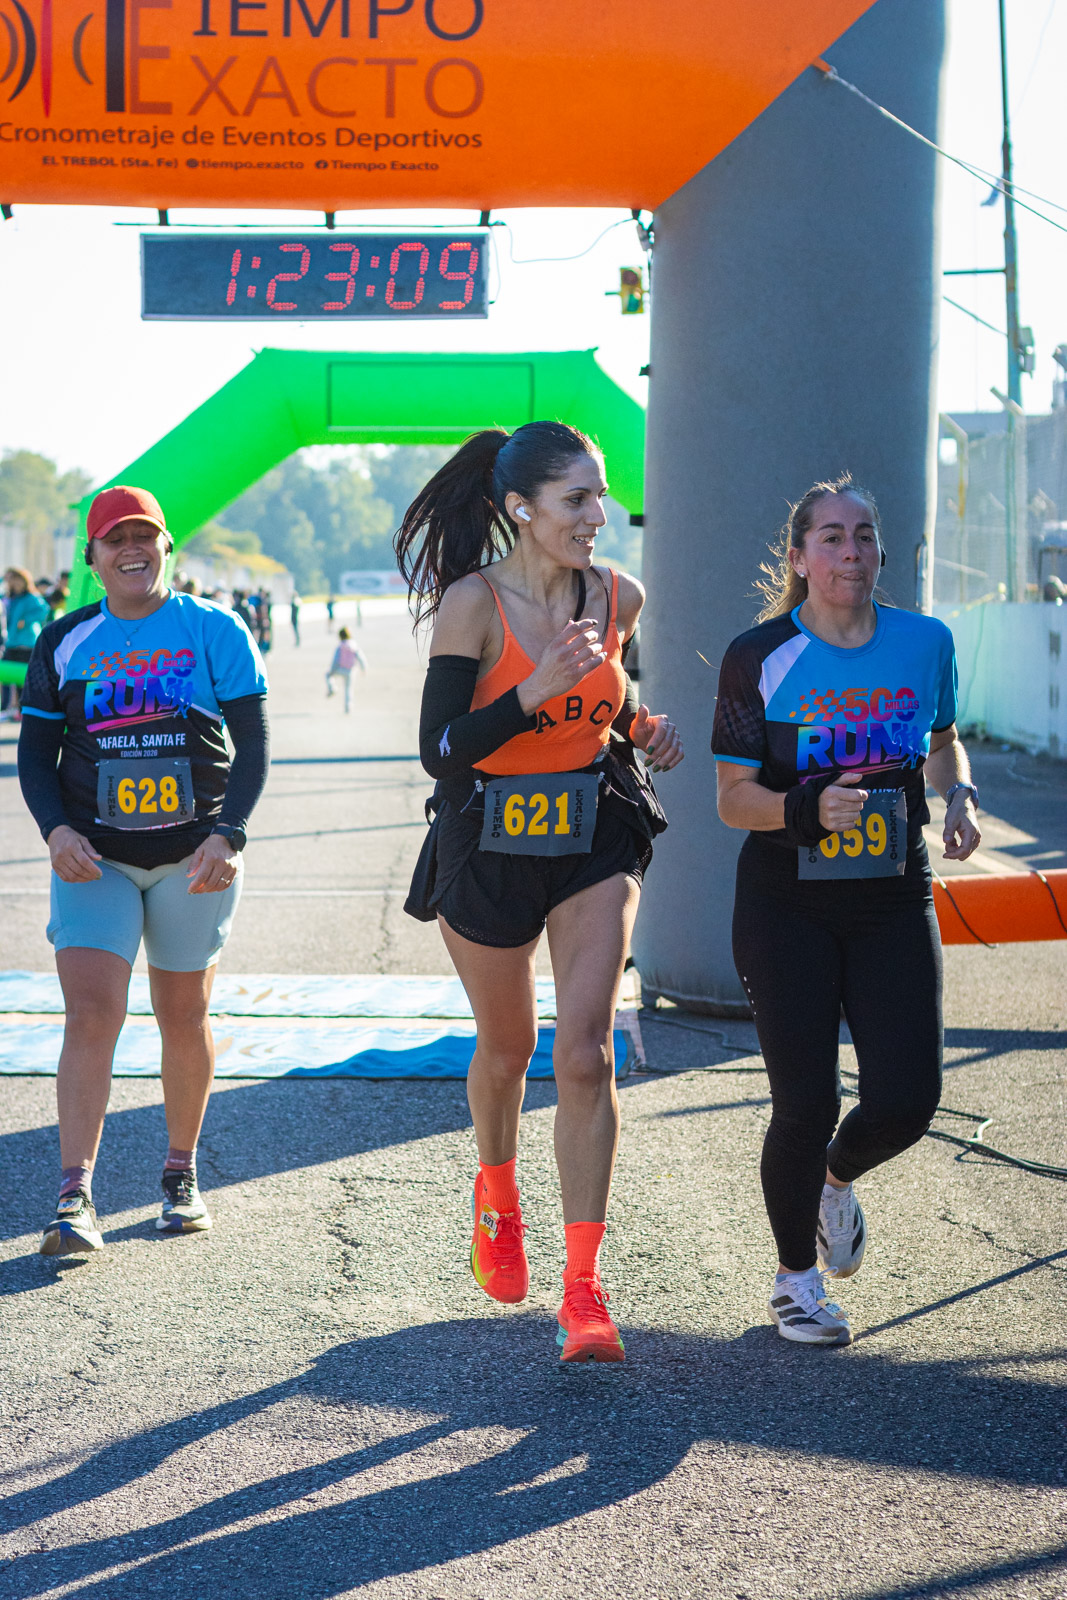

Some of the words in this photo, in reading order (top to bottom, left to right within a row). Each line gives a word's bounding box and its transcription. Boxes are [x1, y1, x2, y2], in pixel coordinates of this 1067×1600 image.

[0, 122, 174, 148] Cronometraje
[182, 125, 214, 145] de
[223, 126, 326, 146] Eventos
[336, 127, 483, 151] Deportivos
[42, 155, 58, 166] EL
[61, 156, 118, 168] TREBOL
[121, 157, 154, 169] (Sta.
[157, 158, 178, 169] Fe)
[331, 160, 387, 171] Tiempo
[390, 161, 439, 171] Exacto
[226, 242, 478, 311] 1:23:09
[885, 700, 920, 711] MILLAS
[796, 723, 905, 772] RUN
[117, 776, 179, 814] 628
[491, 789, 503, 839] TIEMPO
[503, 792, 571, 837] 621
[572, 789, 584, 839] EXACTO
[889, 809, 898, 861] EXACTO
